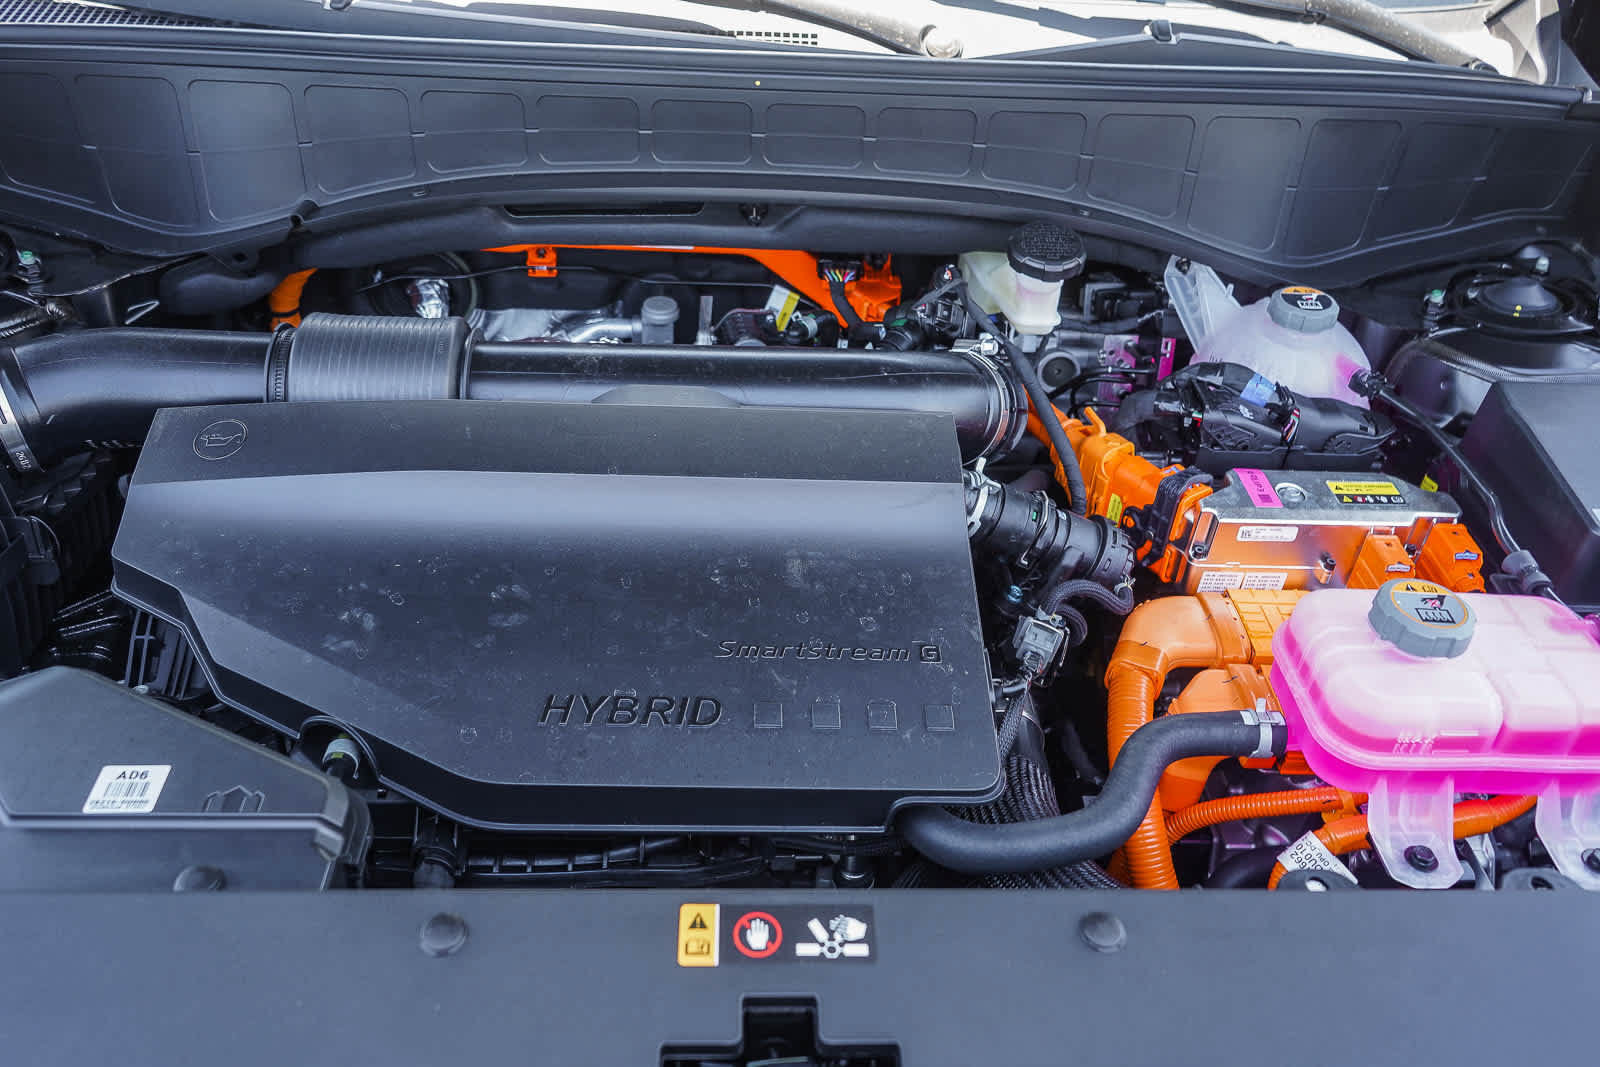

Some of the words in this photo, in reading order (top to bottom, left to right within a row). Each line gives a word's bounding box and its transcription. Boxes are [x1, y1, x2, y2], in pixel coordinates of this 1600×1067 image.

[713, 640, 911, 662] Smartstream
[920, 644, 942, 663] G
[536, 693, 723, 729] HYBRID
[116, 770, 150, 780] AD6
[1289, 850, 1308, 870] 662
